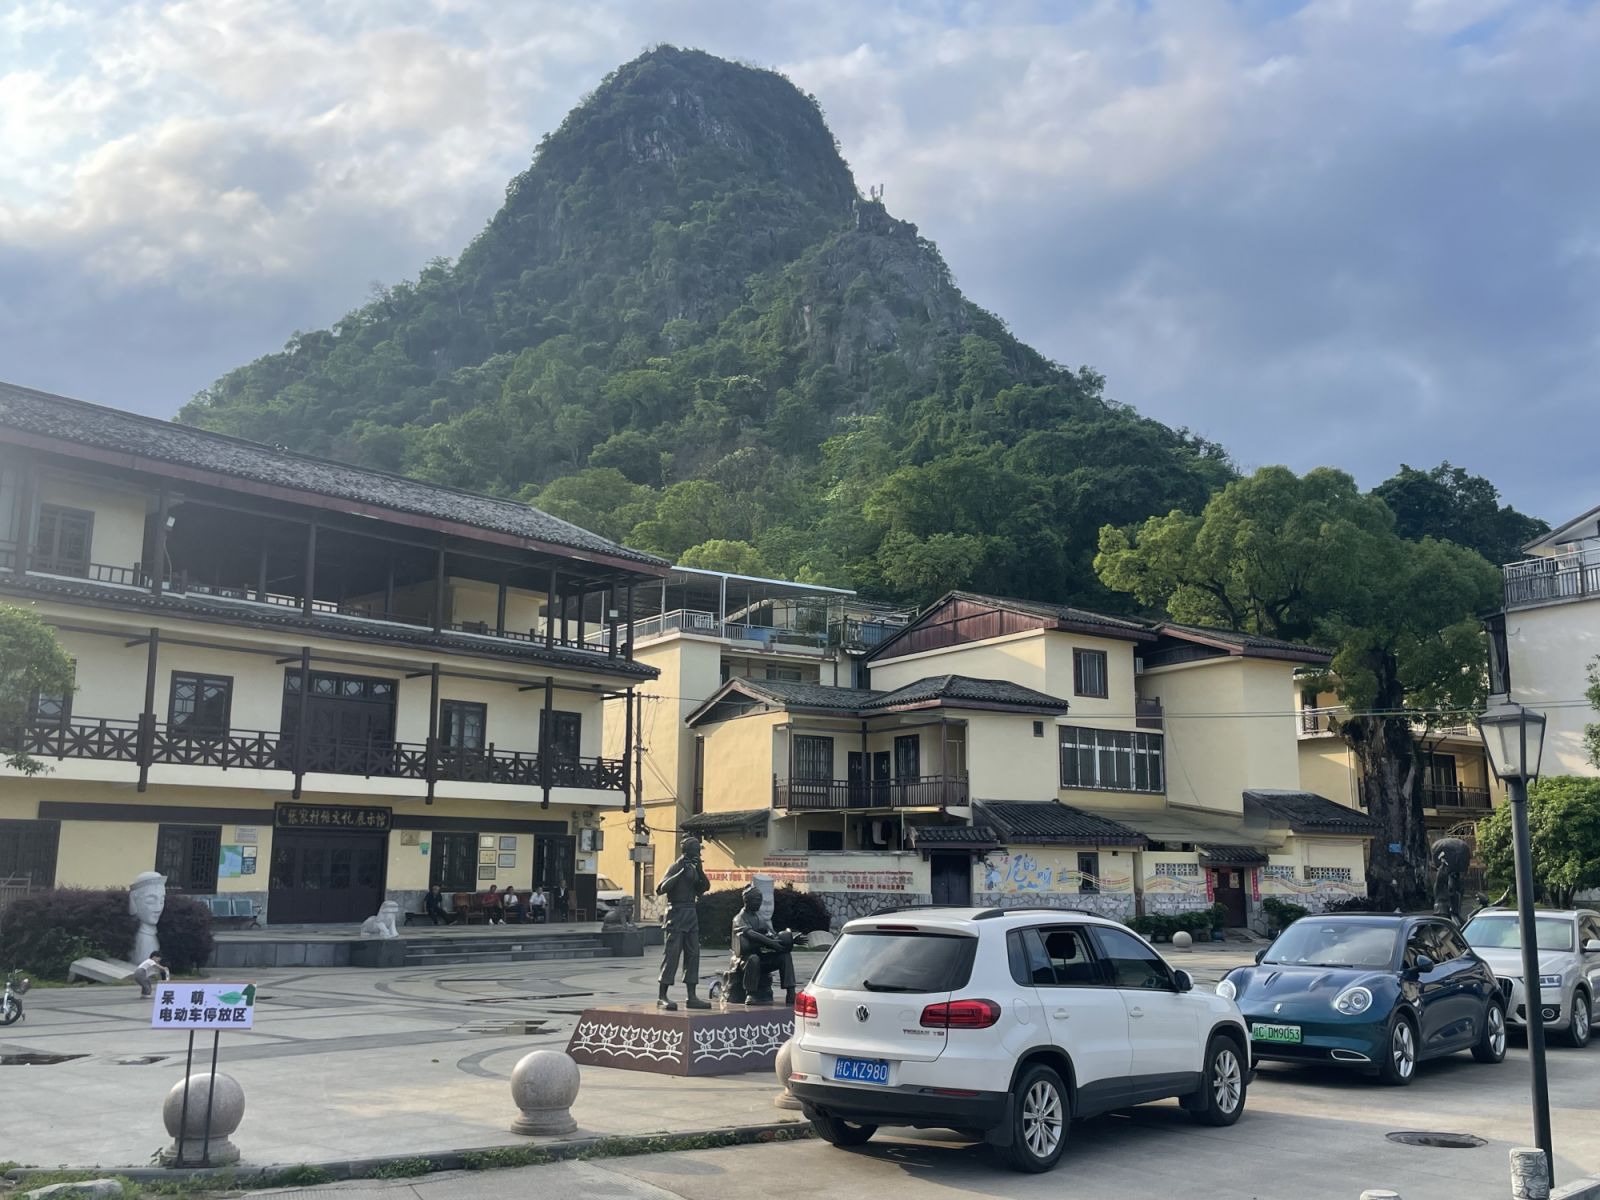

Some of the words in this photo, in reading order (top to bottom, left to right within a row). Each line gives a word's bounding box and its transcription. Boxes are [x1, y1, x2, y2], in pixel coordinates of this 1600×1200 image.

[161, 990, 175, 1005] 呆
[190, 990, 205, 1005] 萌
[159, 1007, 247, 1022] 电动车停放区
